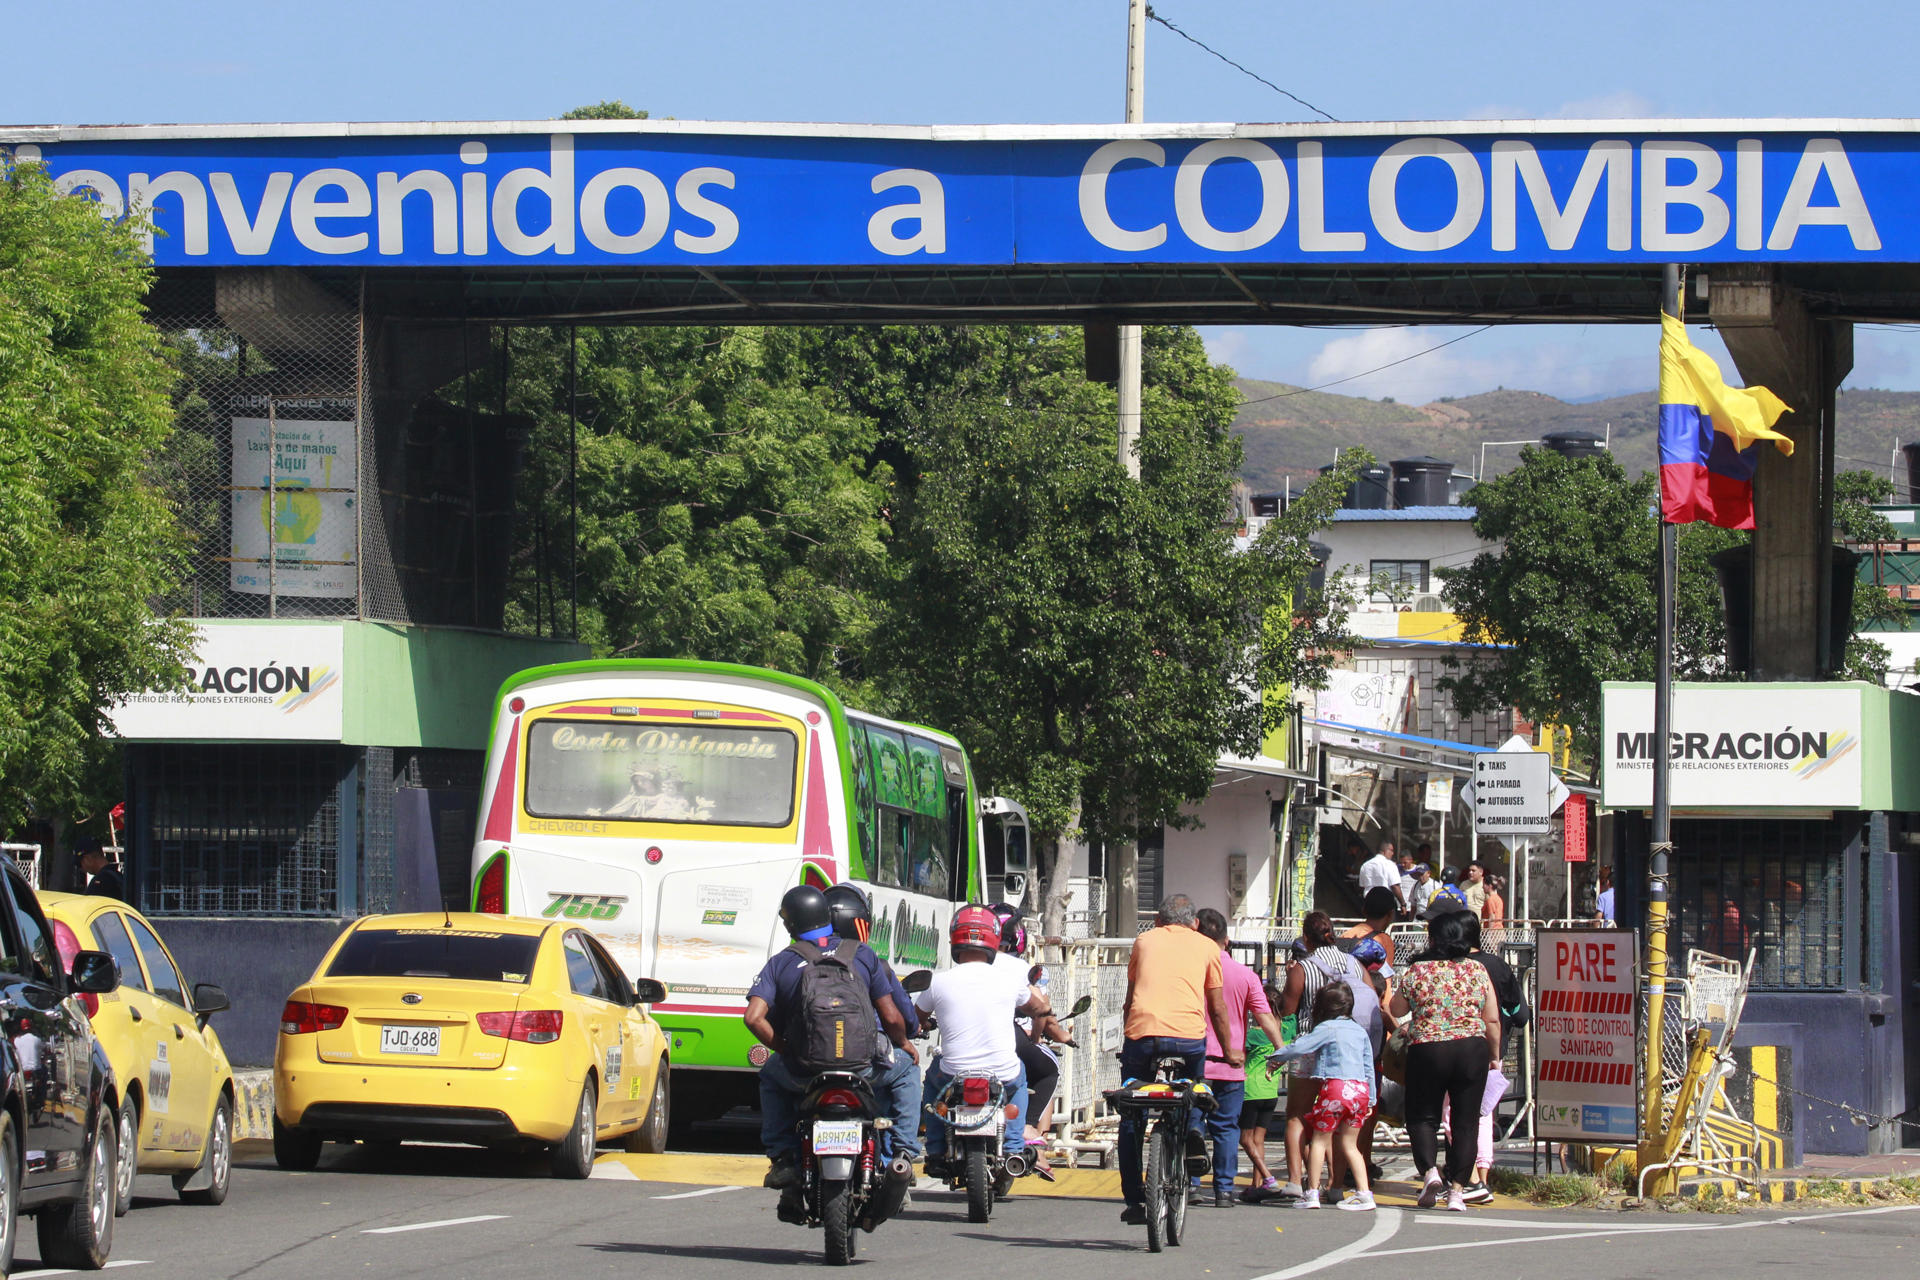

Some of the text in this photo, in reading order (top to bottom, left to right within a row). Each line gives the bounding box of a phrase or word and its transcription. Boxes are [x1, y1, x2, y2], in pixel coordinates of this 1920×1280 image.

[0, 134, 1883, 256] envenidos a COLOMBIA
[247, 439, 337, 455] Lavao de manos
[275, 454, 307, 473] Aquí
[224, 695, 273, 704] EXTERIORES
[636, 730, 777, 759] Distancia
[1488, 761, 1507, 770] TAXIS
[1682, 762, 1736, 770] RELACIONES
[1737, 762, 1789, 770] EXTERIORES
[1487, 780, 1521, 789] LA PARADA
[1487, 797, 1525, 806] AUTOBUSES
[528, 820, 608, 833] CHEVROLET
[1487, 816, 1549, 825] CAMBIO DE DIVISAS
[541, 891, 630, 921] 755
[1556, 941, 1617, 983] PARE
[1538, 1016, 1634, 1037] PUESTO DE CONTROL
[1560, 1038, 1614, 1057] SANITARIO
[1538, 1104, 1556, 1122] ICA
